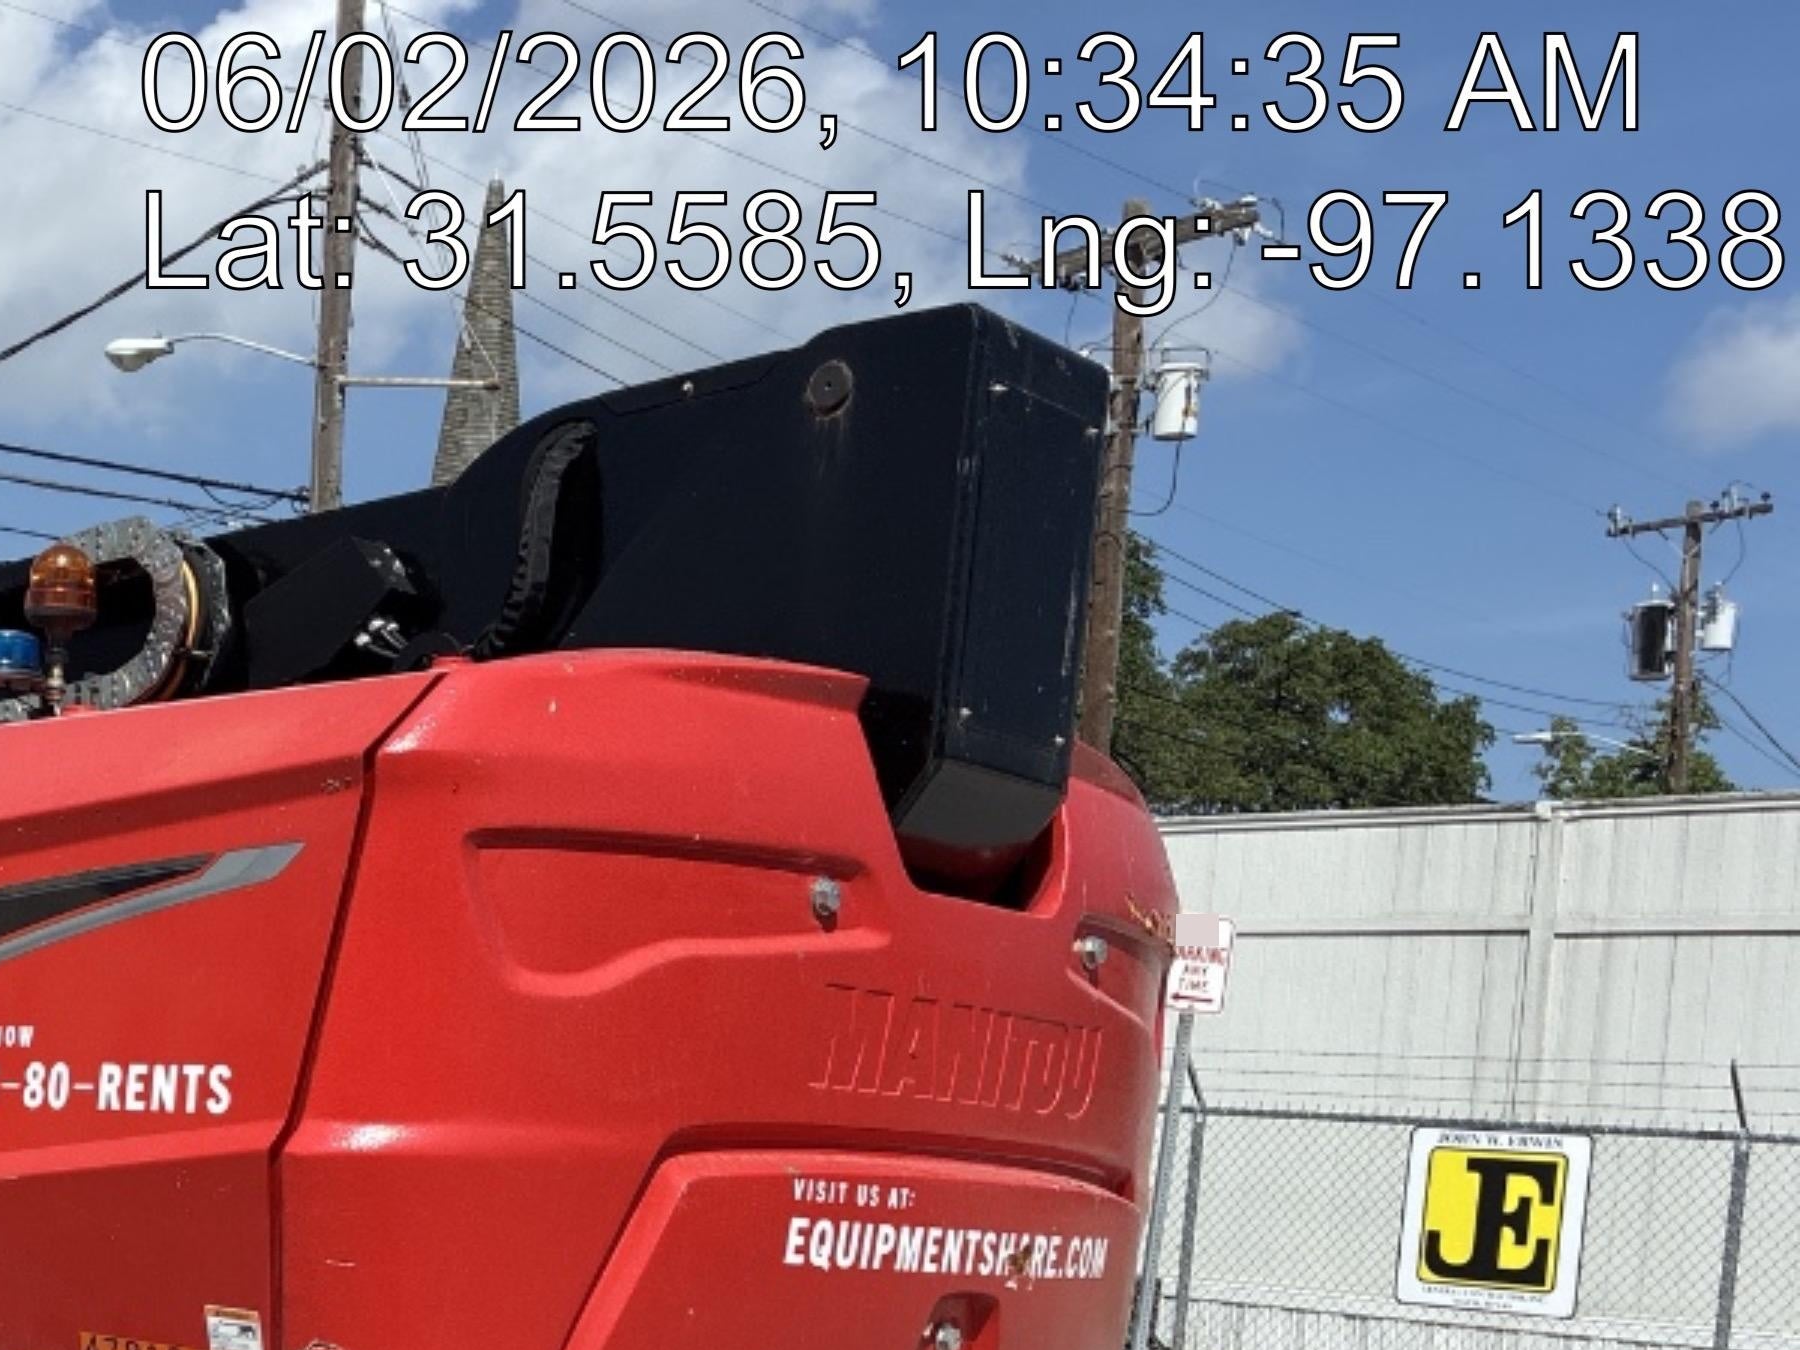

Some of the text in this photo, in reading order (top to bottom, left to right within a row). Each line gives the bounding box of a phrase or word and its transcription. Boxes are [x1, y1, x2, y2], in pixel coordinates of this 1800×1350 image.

[808, 982, 1103, 1121] MANITOU
[792, 1178, 917, 1210] VISIT US AT:
[1425, 1157, 1559, 1287] JE
